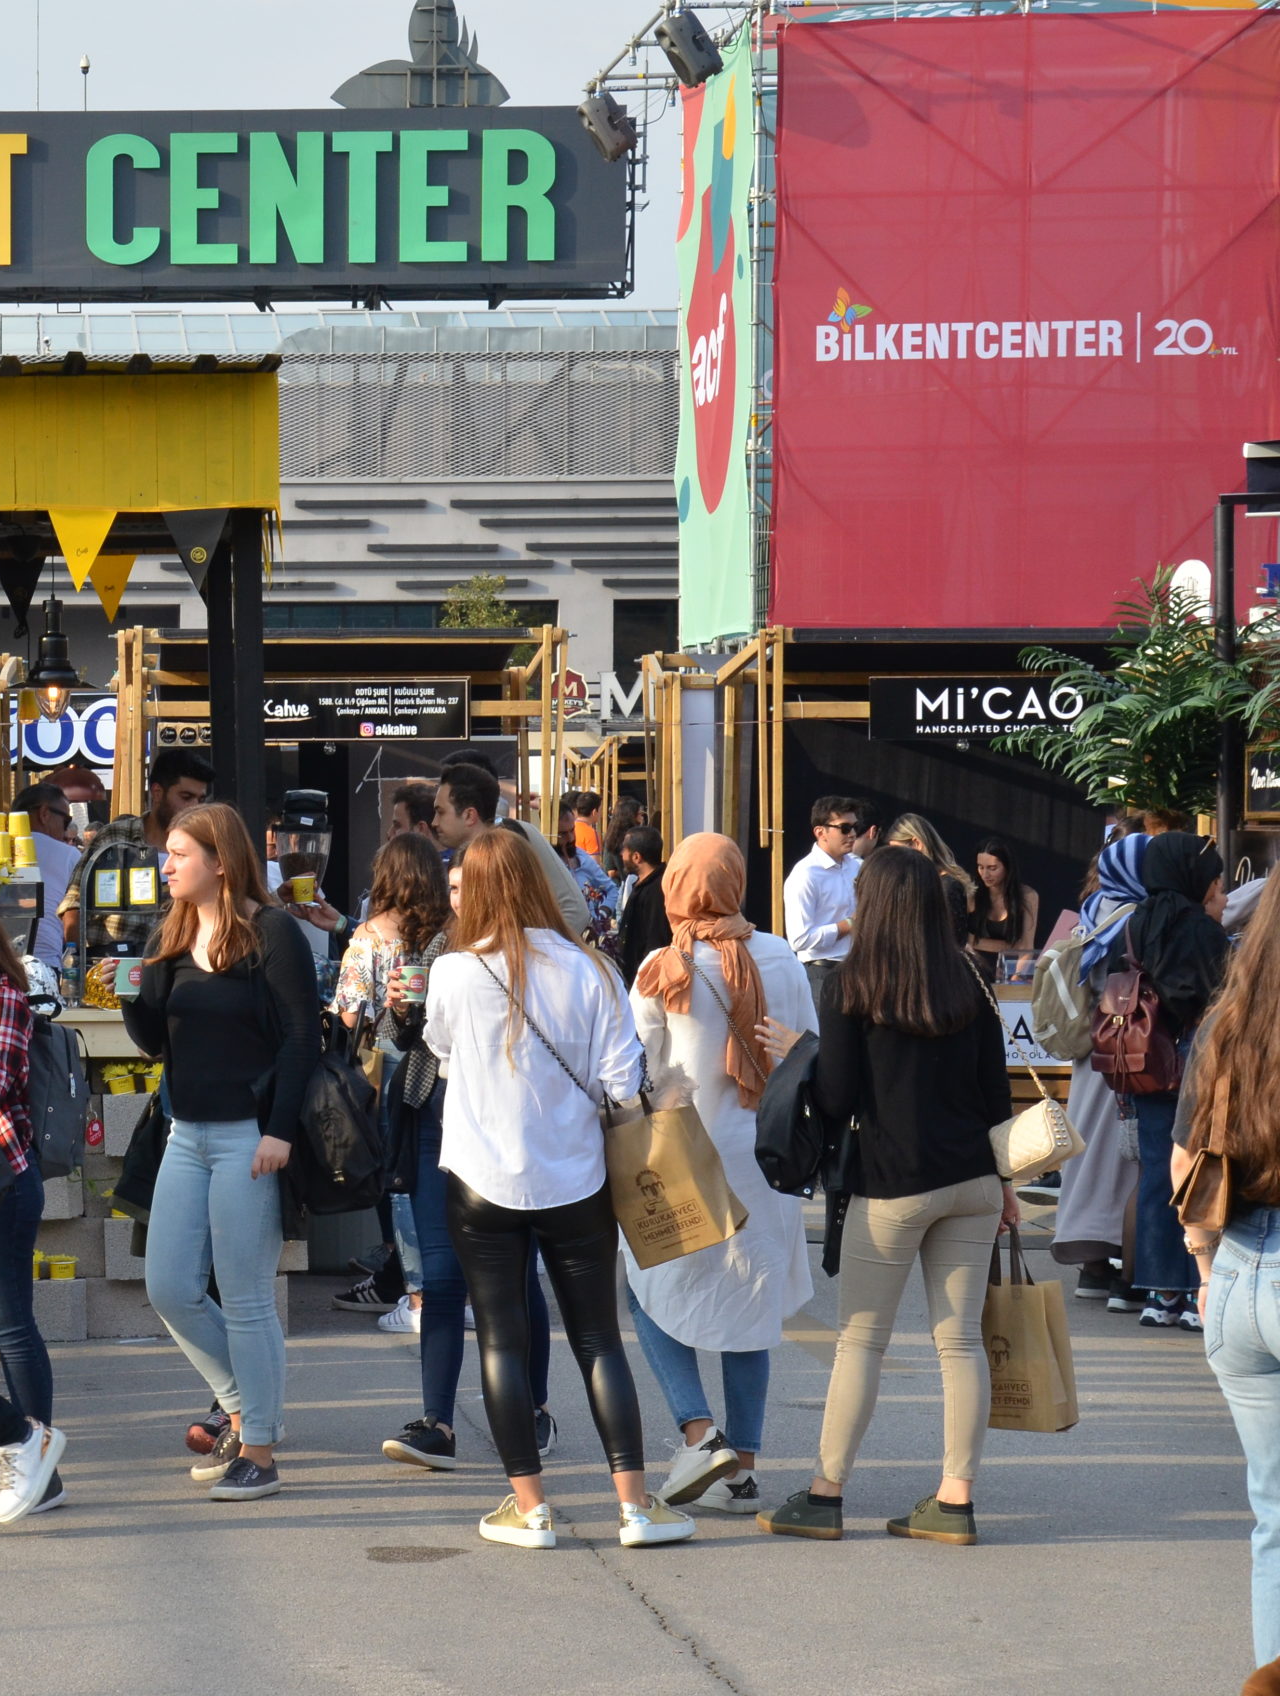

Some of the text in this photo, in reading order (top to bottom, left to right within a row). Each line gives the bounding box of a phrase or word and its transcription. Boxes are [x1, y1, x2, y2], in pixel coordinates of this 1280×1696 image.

[85, 127, 556, 266] CENTER
[691, 292, 727, 409] acf
[375, 723, 418, 736] a4kahve
[916, 724, 1000, 733] HANDCRAFTED
